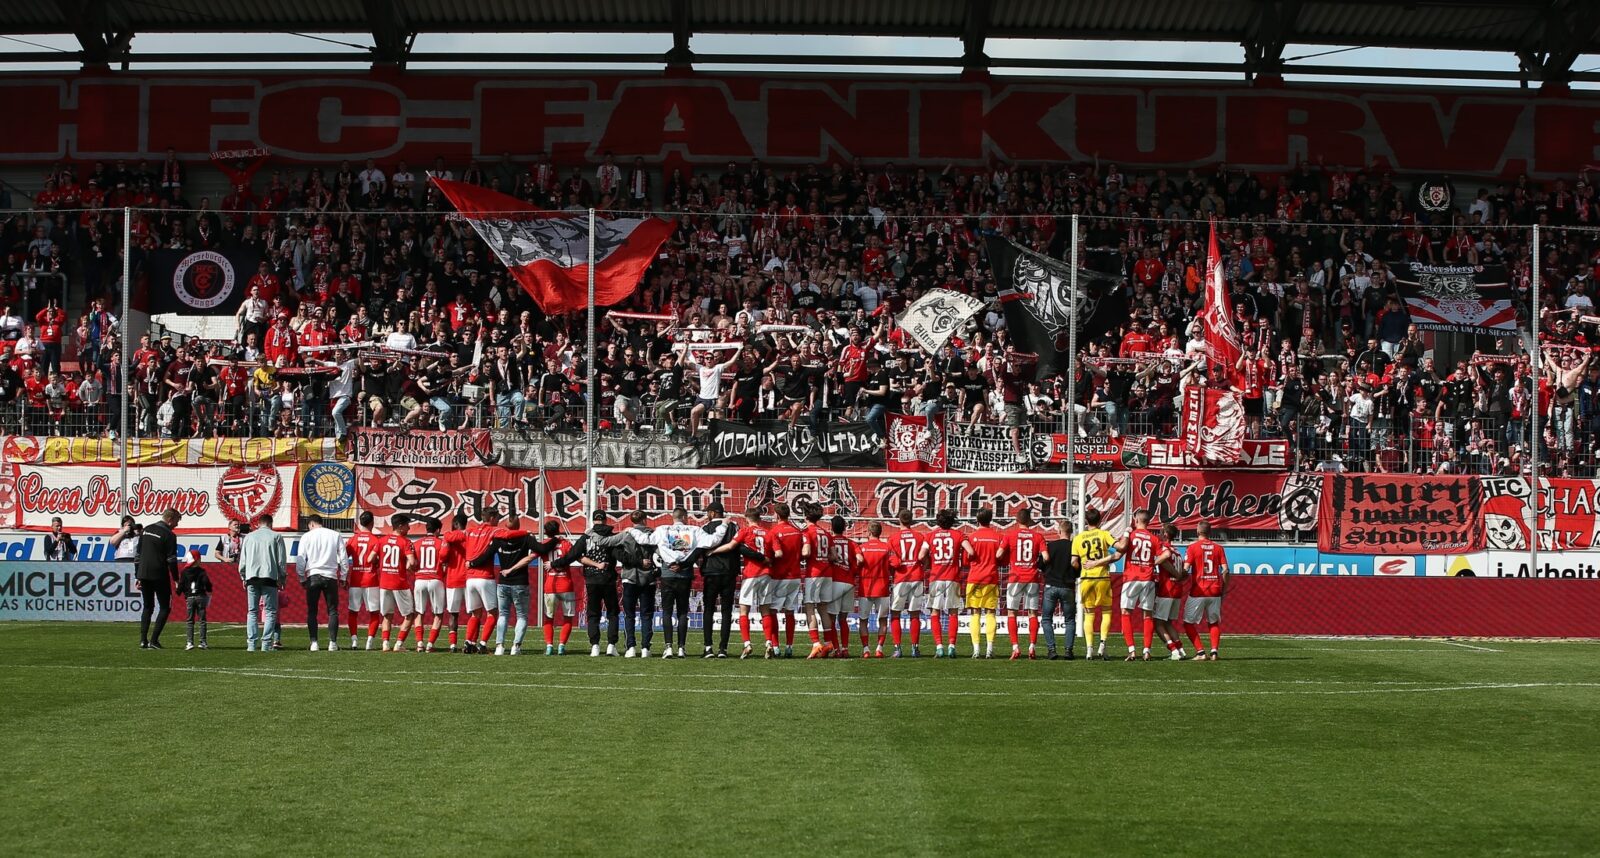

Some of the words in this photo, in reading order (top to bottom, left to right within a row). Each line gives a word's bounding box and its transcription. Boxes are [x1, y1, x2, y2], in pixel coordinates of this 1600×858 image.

[1410, 262, 1474, 273] Petersberg
[913, 323, 938, 349] Ultras
[1475, 327, 1487, 335] ZU
[816, 432, 881, 455] ULTRAS
[1056, 444, 1119, 454] MNSFELD
[1074, 436, 1109, 444] EKTION
[18, 472, 83, 513] Coesa
[791, 481, 815, 490] HFC
[1482, 479, 1522, 499] HFC
[1140, 474, 1282, 523] Köthen
[357, 543, 368, 566] 7
[382, 544, 400, 568] 20
[755, 536, 765, 554] 9
[816, 534, 828, 558] 19
[900, 538, 916, 561] 17
[932, 537, 954, 560] 33
[1016, 539, 1033, 561] 18
[1081, 537, 1103, 560] 23
[1130, 538, 1152, 562] 26
[420, 546, 436, 569] 10
[1203, 551, 1213, 574] 5
[26, 598, 142, 611] KÜCHENSTUDIO
